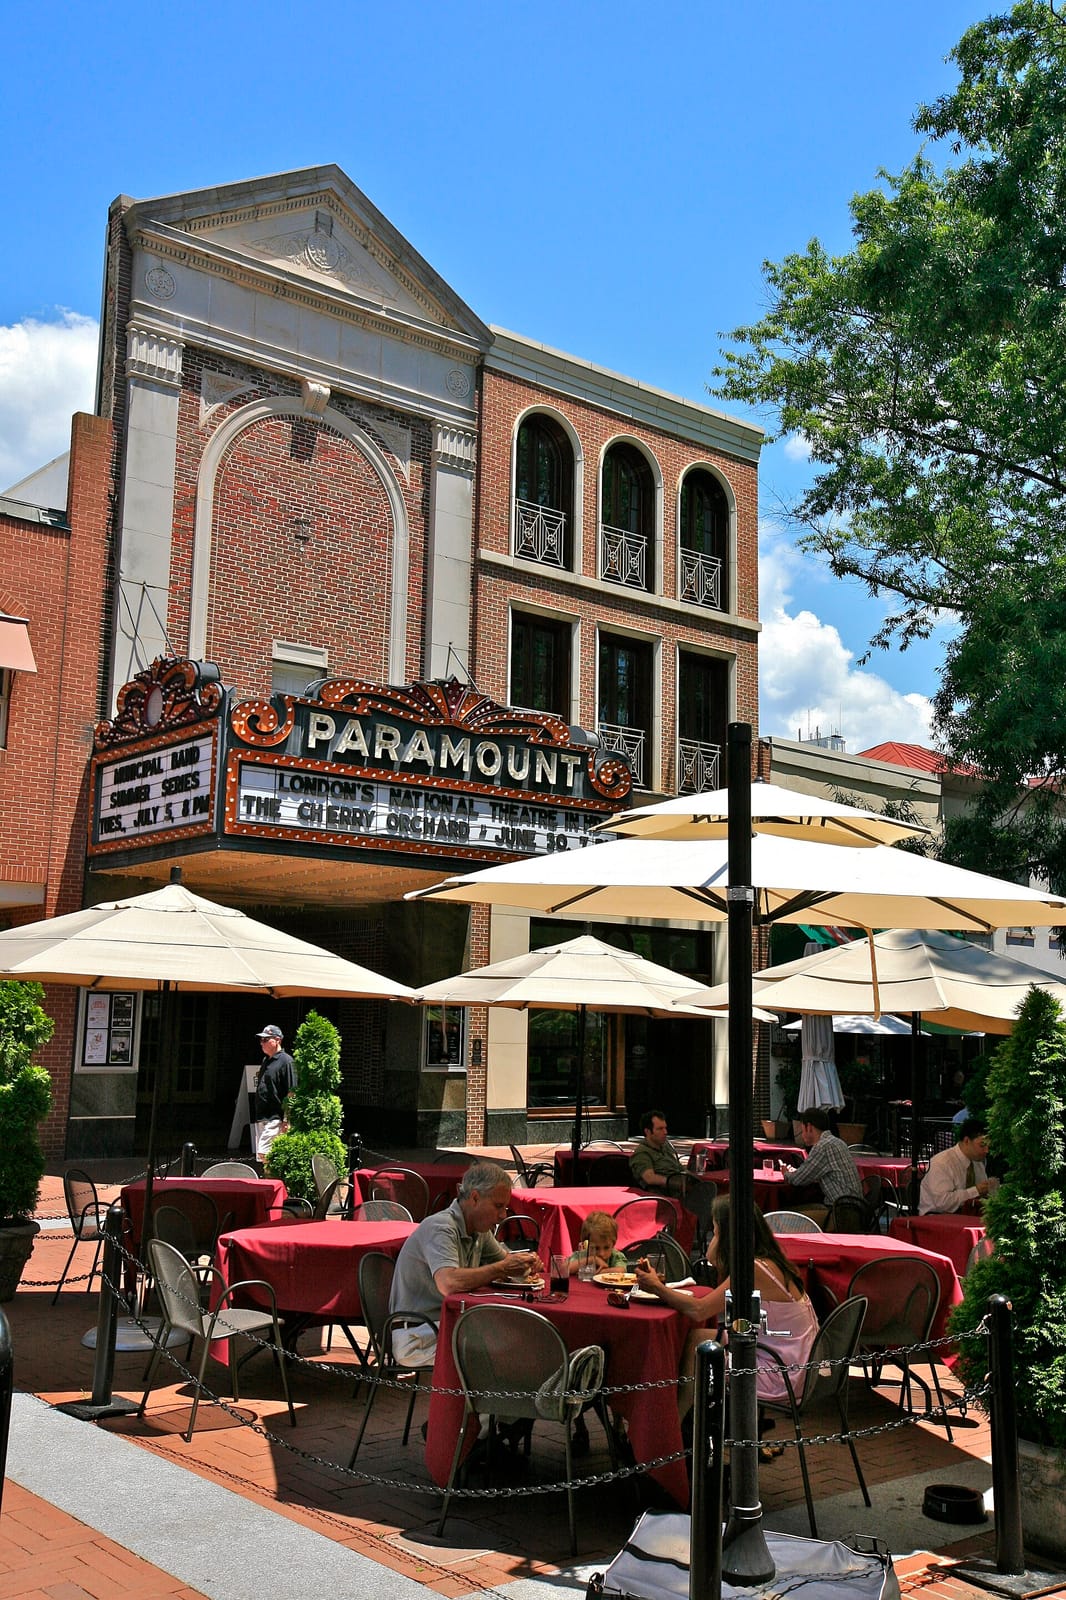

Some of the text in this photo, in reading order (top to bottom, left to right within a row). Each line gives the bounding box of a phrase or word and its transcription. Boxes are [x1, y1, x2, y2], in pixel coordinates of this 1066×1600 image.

[113, 746, 200, 785] MUNICIPAL BAND
[308, 712, 581, 787] PARAMOUNT
[110, 770, 200, 808] SUMMER SERIES
[133, 805, 160, 827] JULY
[181, 798, 190, 817] 8
[192, 794, 211, 815] PM
[279, 773, 375, 802] LONDON'S
[389, 787, 479, 817] NATIONAL
[489, 801, 559, 830] THEATRE
[564, 811, 580, 831] IN
[243, 794, 282, 818] THE
[297, 801, 376, 828] CHERRY
[386, 812, 471, 840] ORCHARD
[494, 826, 538, 848] JUNE
